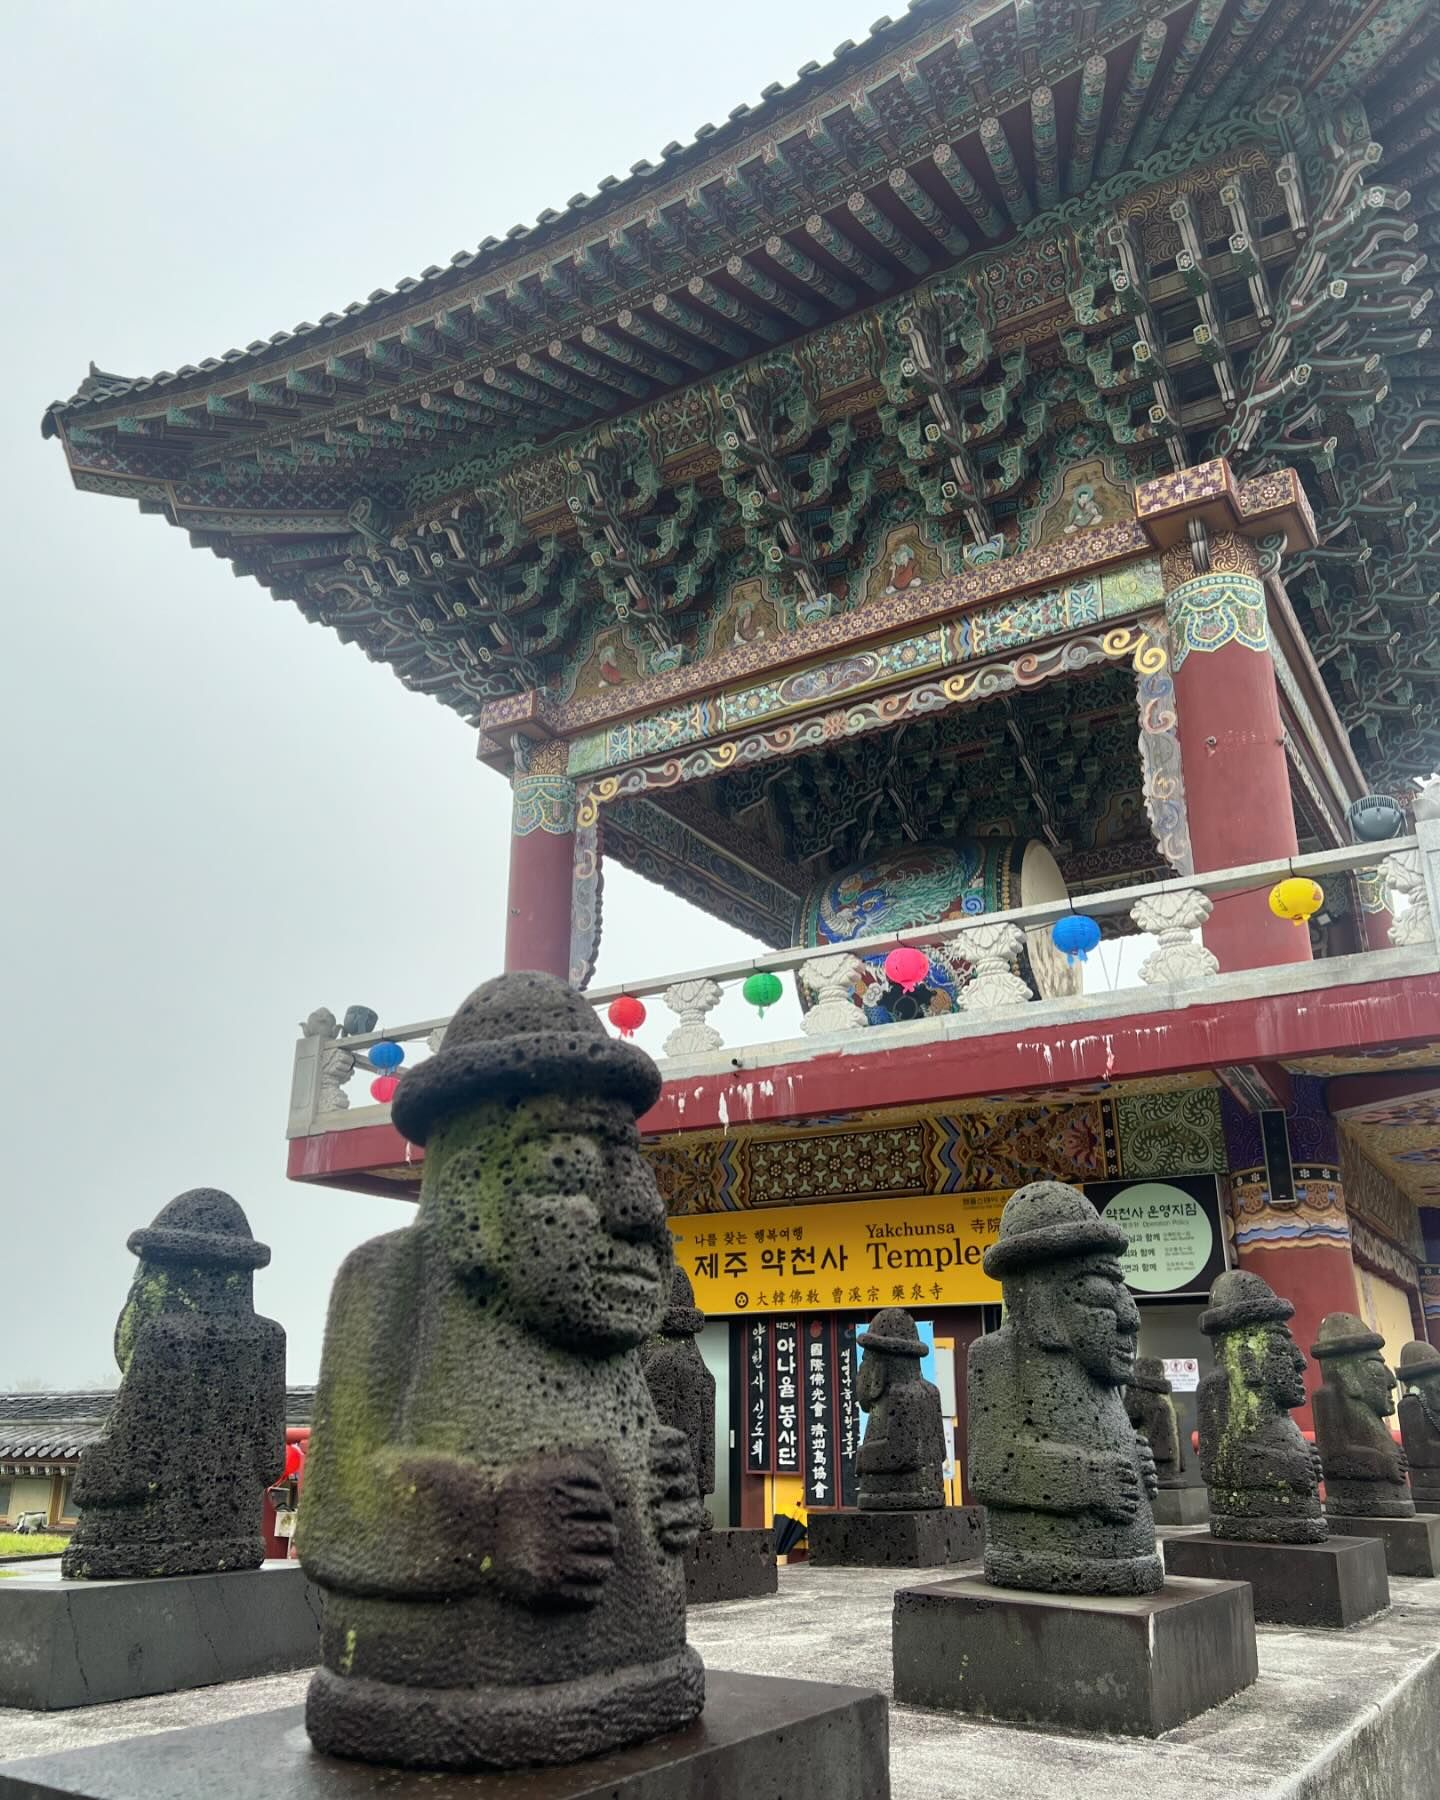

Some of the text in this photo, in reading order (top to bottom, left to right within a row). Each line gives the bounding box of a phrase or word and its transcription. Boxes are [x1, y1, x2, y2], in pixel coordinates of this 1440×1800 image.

[1106, 1203, 1197, 1220] 약천사 운영지침
[695, 1226, 803, 1248] 나를 찾는 행복여행
[865, 1222, 955, 1239] Yakchunsa
[694, 1244, 848, 1279] 제주 약천사
[866, 1237, 991, 1273] Temple
[750, 1322, 766, 1465] 약천사 신도회
[777, 1337, 797, 1465] 아나율 봉사단
